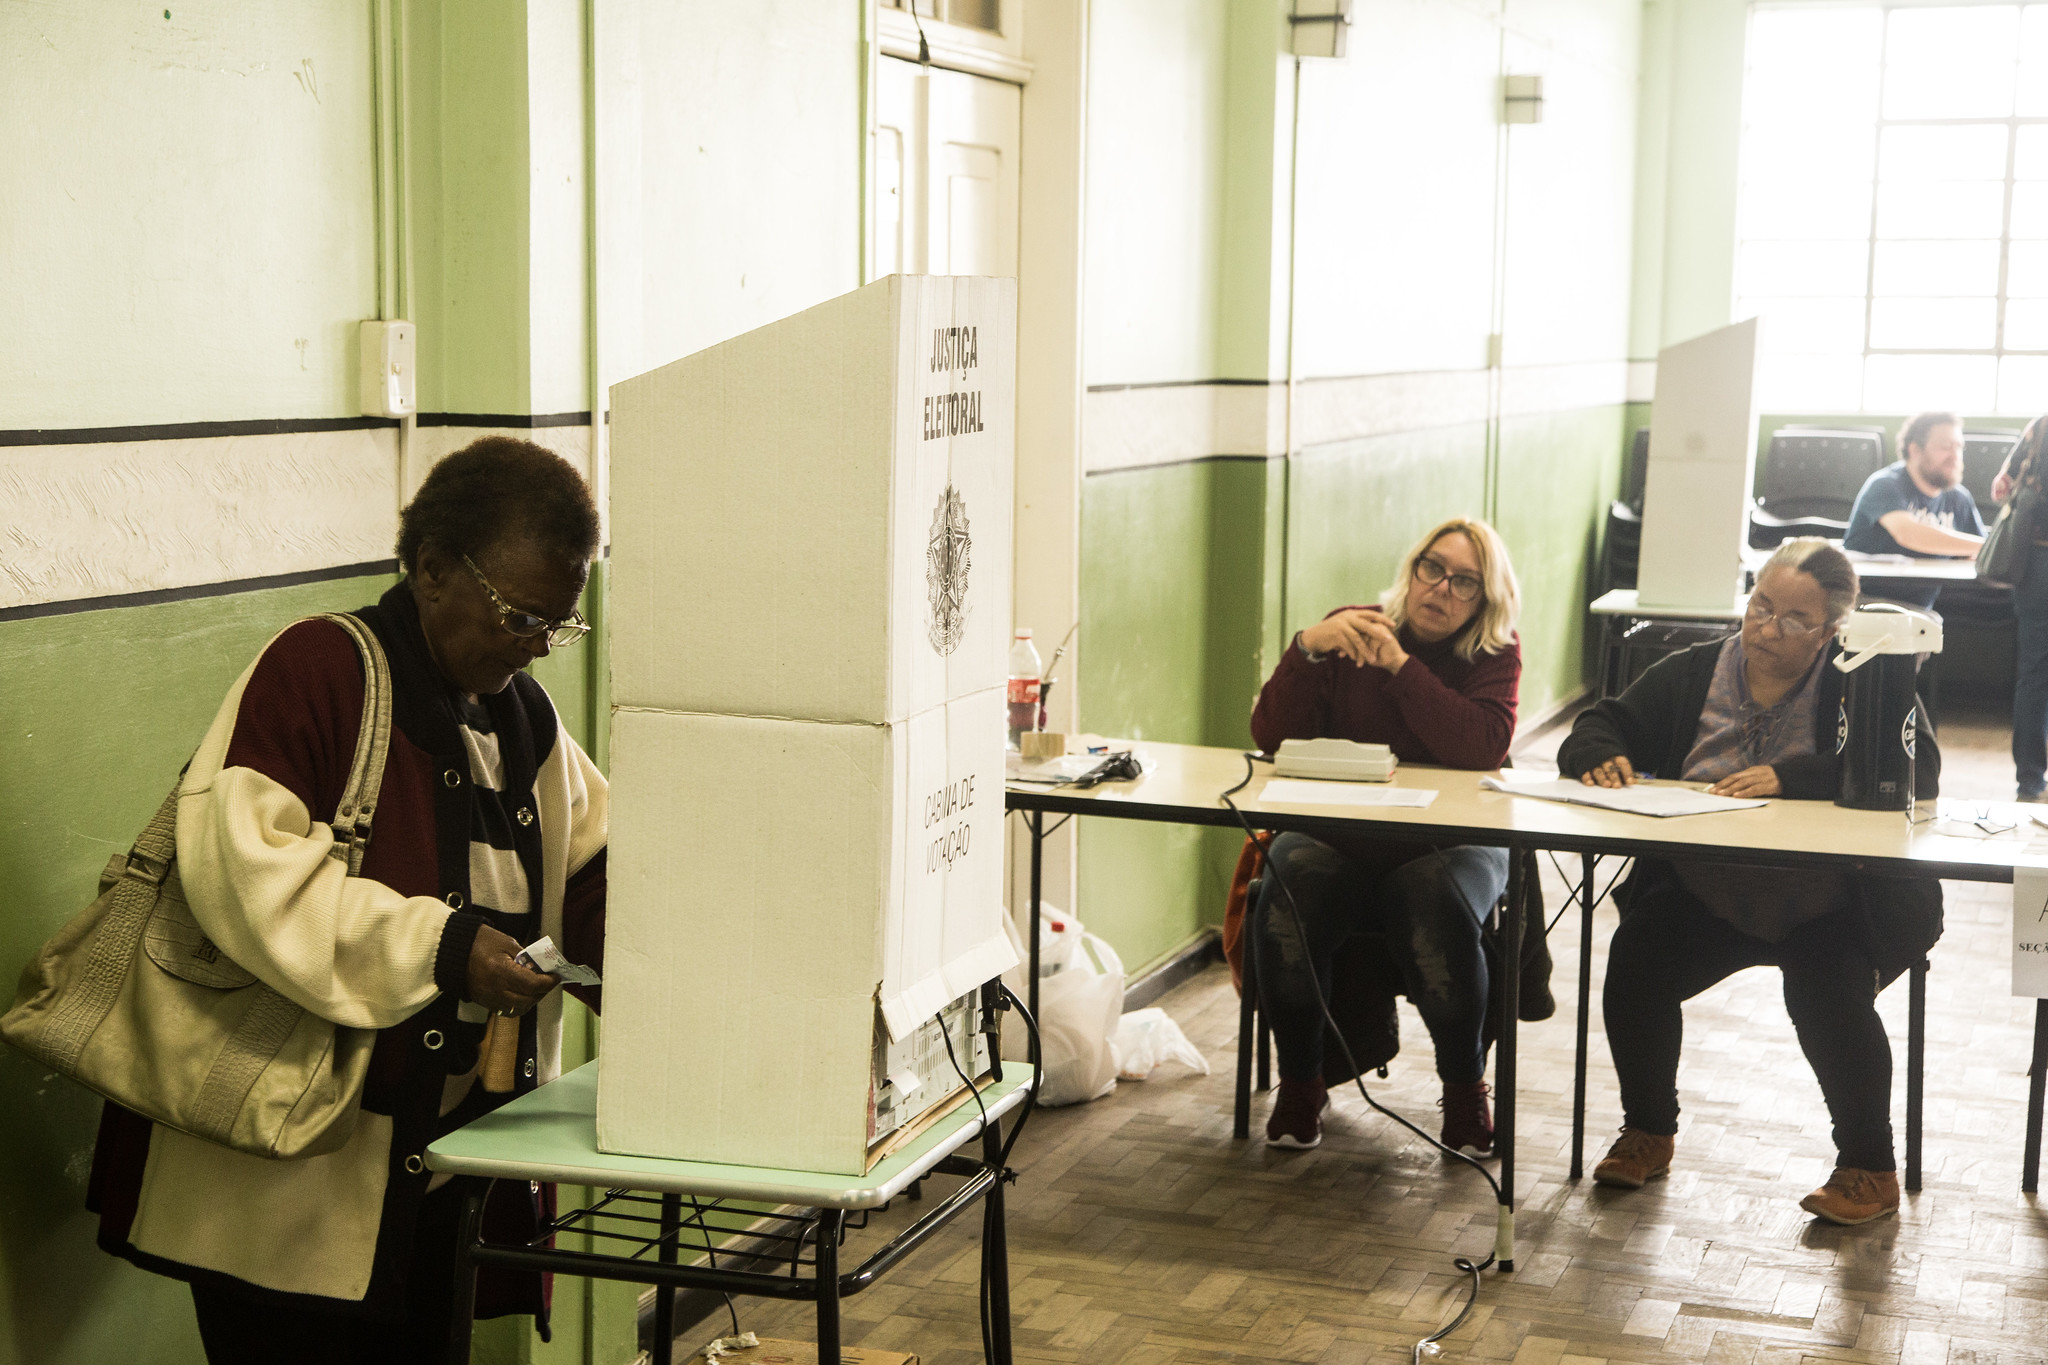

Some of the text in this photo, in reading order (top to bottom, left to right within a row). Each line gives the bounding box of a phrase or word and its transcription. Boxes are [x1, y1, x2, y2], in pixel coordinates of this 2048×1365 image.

[930, 326, 978, 381] JUSTIÇA
[923, 390, 984, 442] ELEITORAL
[960, 774, 976, 811] DE
[926, 820, 971, 875] VOTAÇÃO
